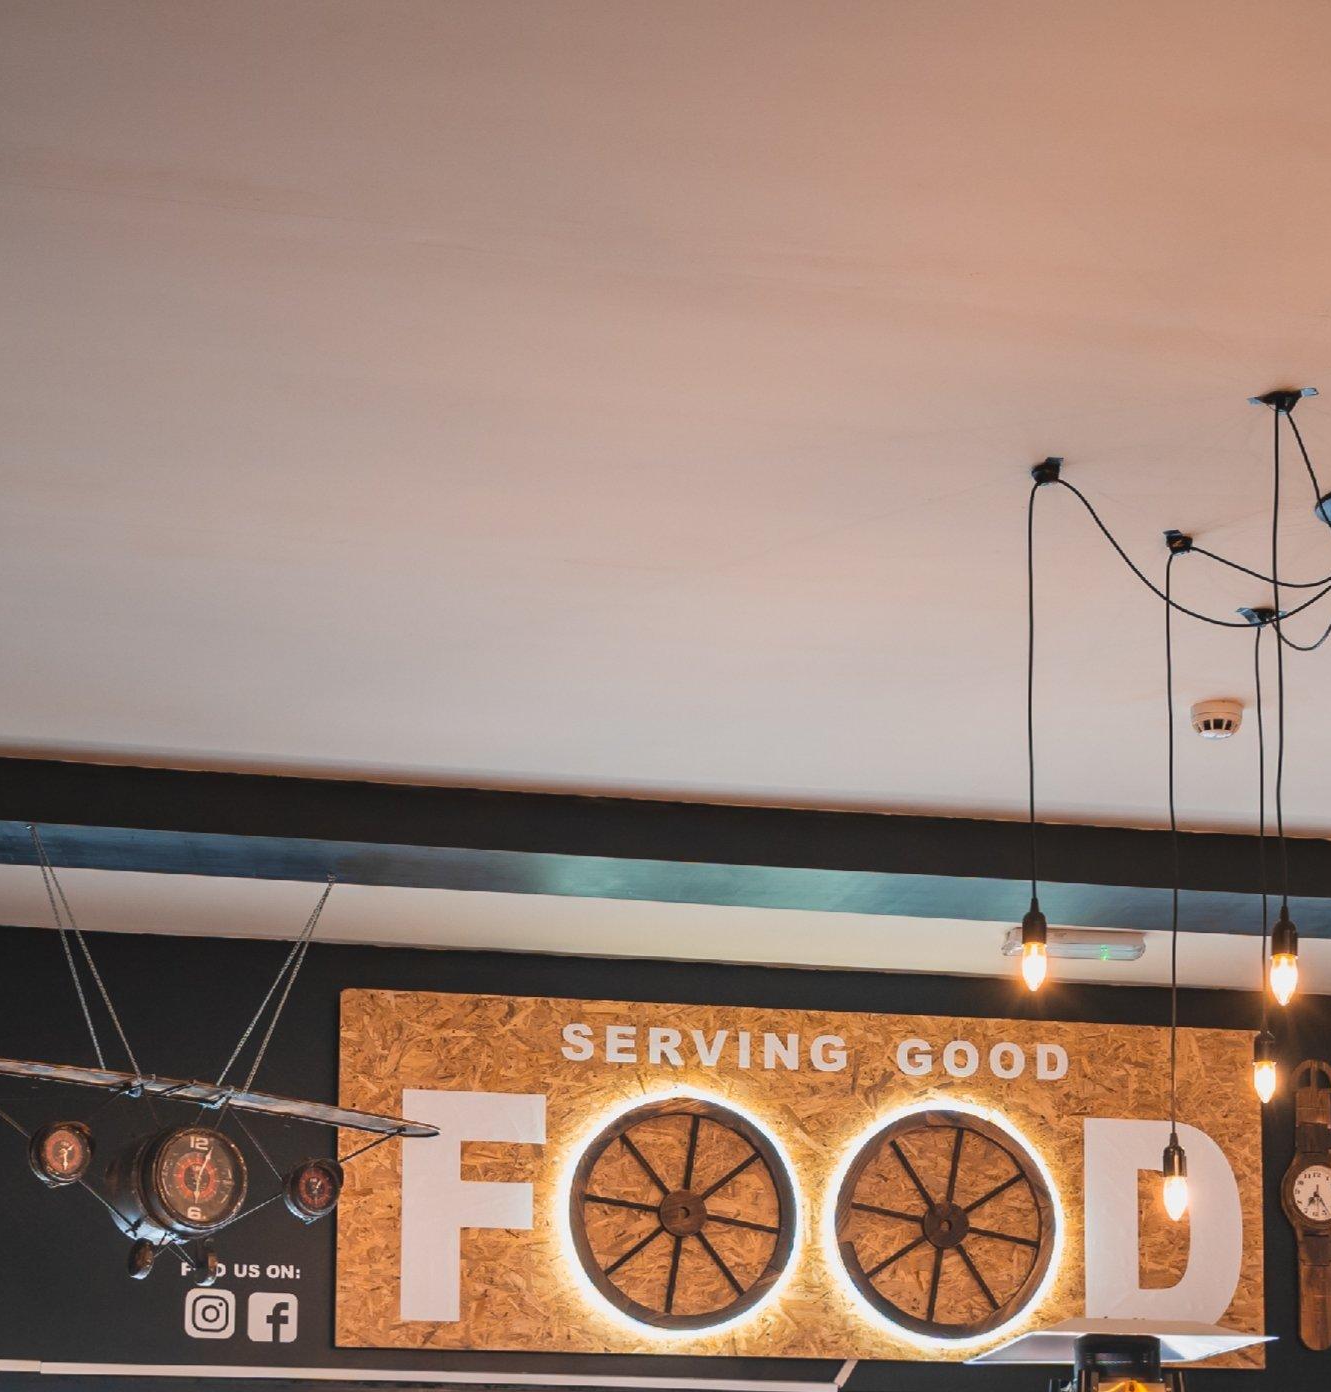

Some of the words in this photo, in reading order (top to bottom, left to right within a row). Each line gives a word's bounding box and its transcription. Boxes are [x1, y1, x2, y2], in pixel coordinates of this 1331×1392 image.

[561, 1022, 848, 1072] SERVING
[896, 1038, 1069, 1081] GOOD
[180, 1262, 227, 1278] FD
[233, 1264, 261, 1279] US
[265, 1264, 301, 1280] ON:
